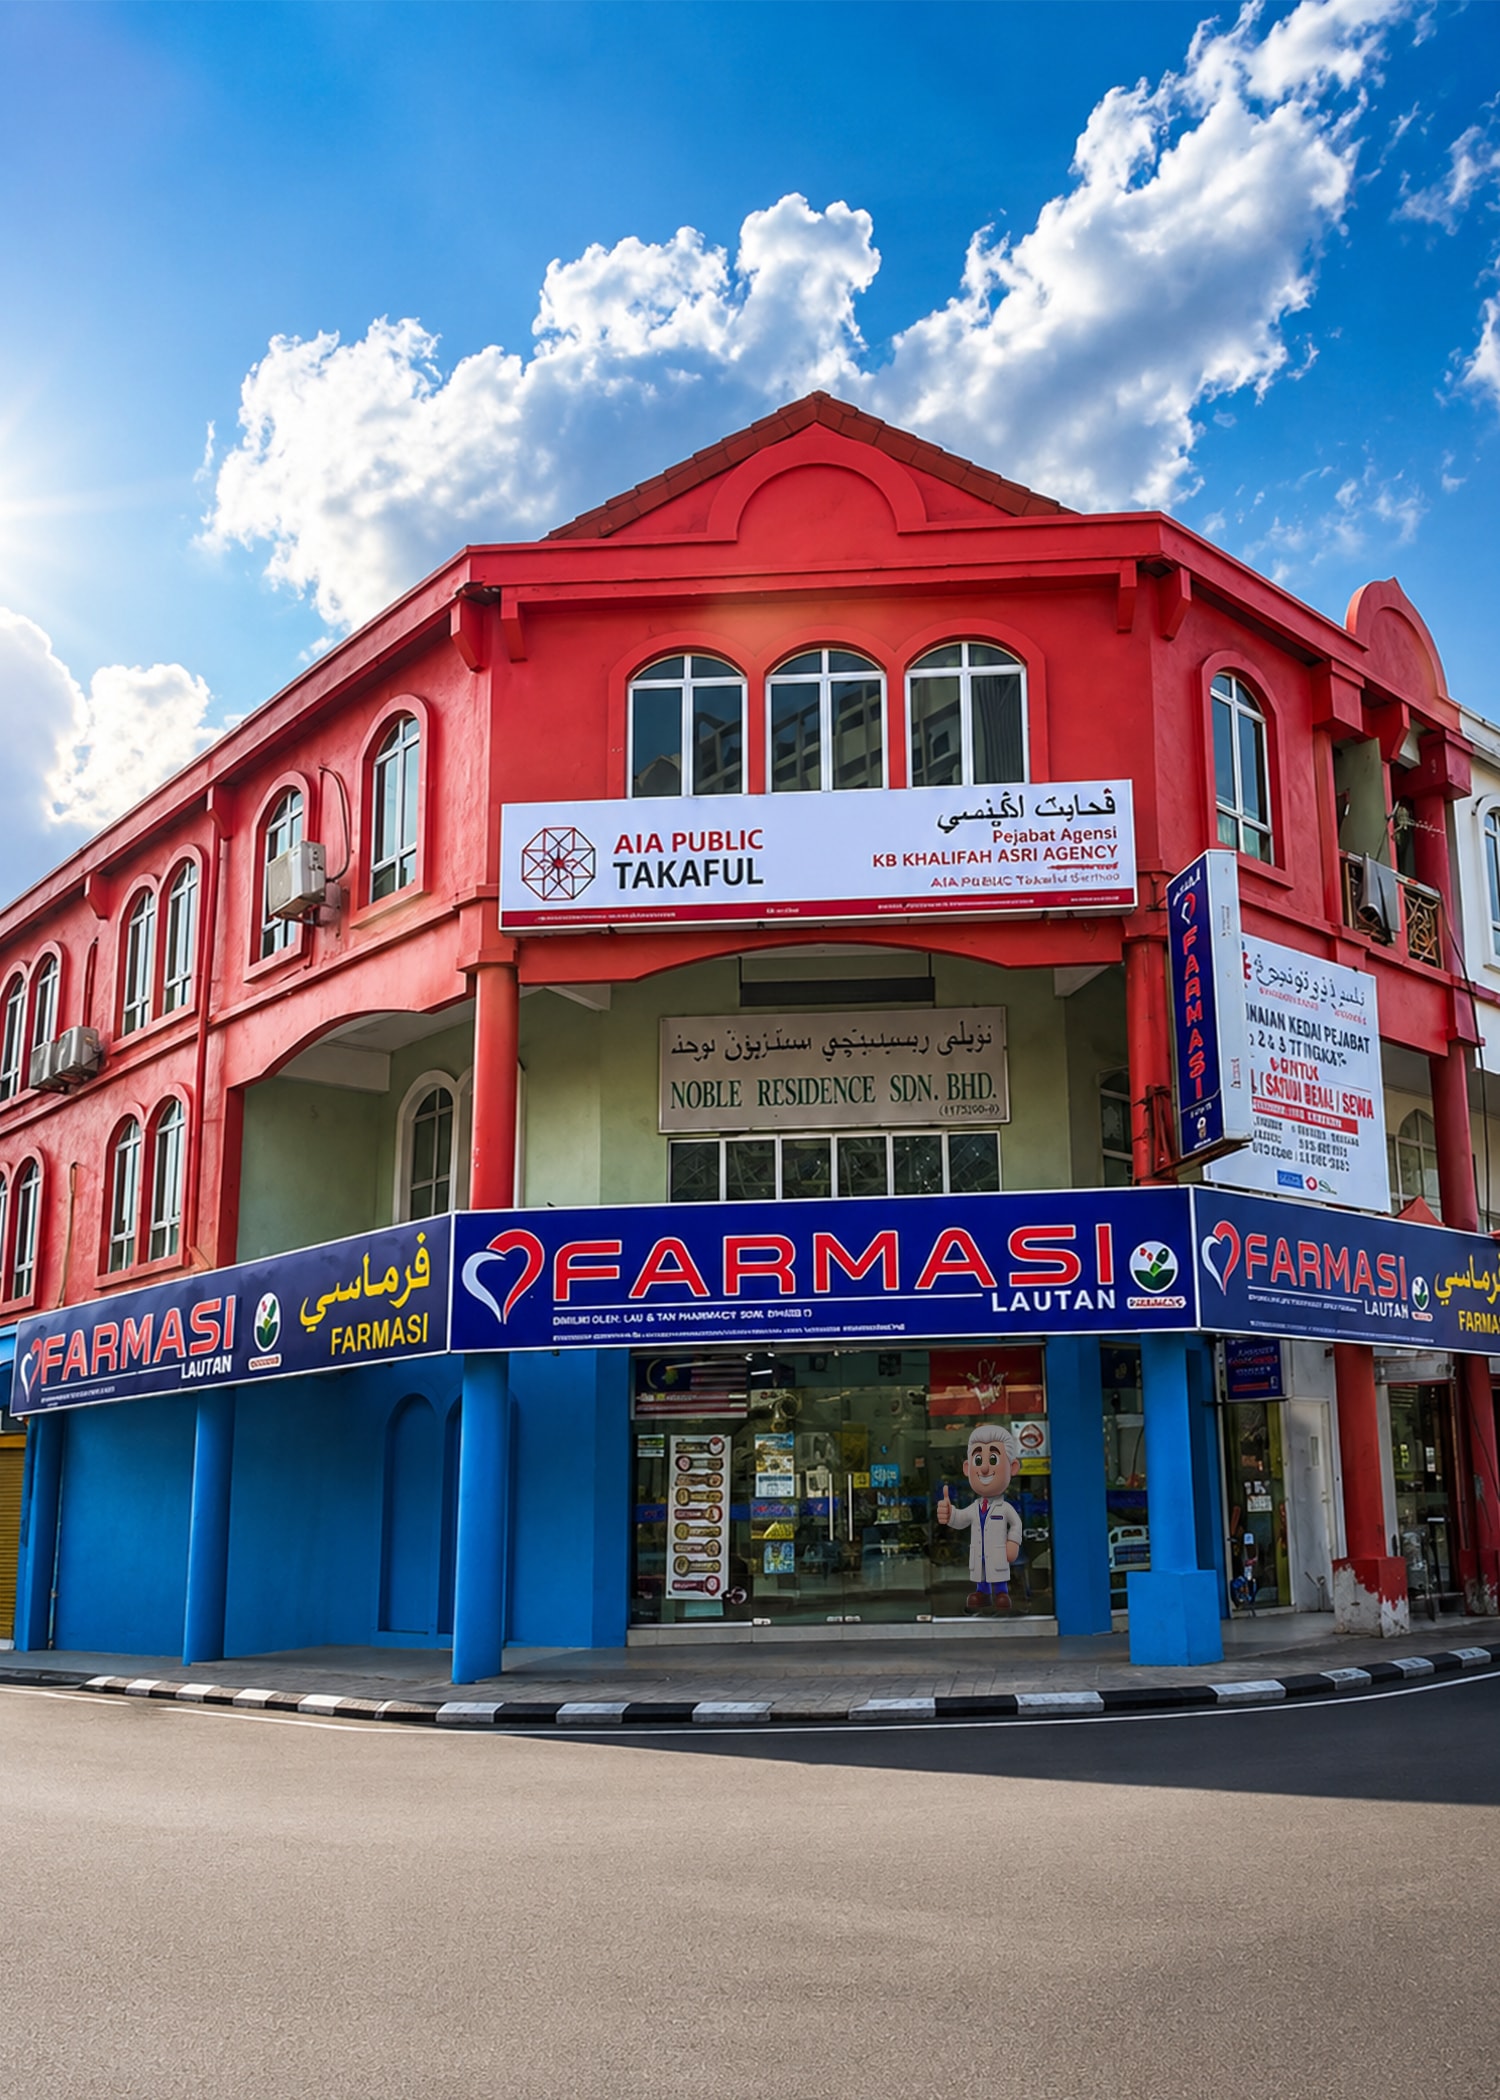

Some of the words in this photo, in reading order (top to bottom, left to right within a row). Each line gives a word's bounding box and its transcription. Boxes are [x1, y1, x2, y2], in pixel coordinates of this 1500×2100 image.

[613, 833, 664, 854] AIA
[671, 829, 764, 852] PUBLIC
[992, 828, 1056, 846] Pejabat
[1060, 826, 1117, 844] Agensi
[612, 857, 764, 889] TAKAFUL
[872, 852, 897, 868] KB
[902, 850, 992, 866] KHALIFAH
[997, 847, 1037, 862] ASRI
[1043, 844, 1118, 862] AGENCY
[1182, 924, 1207, 1100] FARMASI
[1288, 1015, 1322, 1041] KEDAI
[1323, 1026, 1370, 1054] PEJABAT
[670, 1080, 742, 1109] NOBLE
[756, 1075, 876, 1107] RESIDENCE
[889, 1074, 939, 1103] SDN.
[946, 1072, 997, 1101] BHD.
[553, 1223, 1114, 1302] FARMASI
[1245, 1232, 1408, 1301] FARMASI
[1434, 1252, 1500, 1306] رماسي
[300, 1232, 430, 1333] فرماسي
[991, 1288, 1116, 1313] LAUTAN
[1364, 1299, 1409, 1320] LAUTAN
[41, 1295, 237, 1385] FARMASI
[330, 1312, 429, 1356] FARMASI
[181, 1354, 233, 1380] LAUTAN
